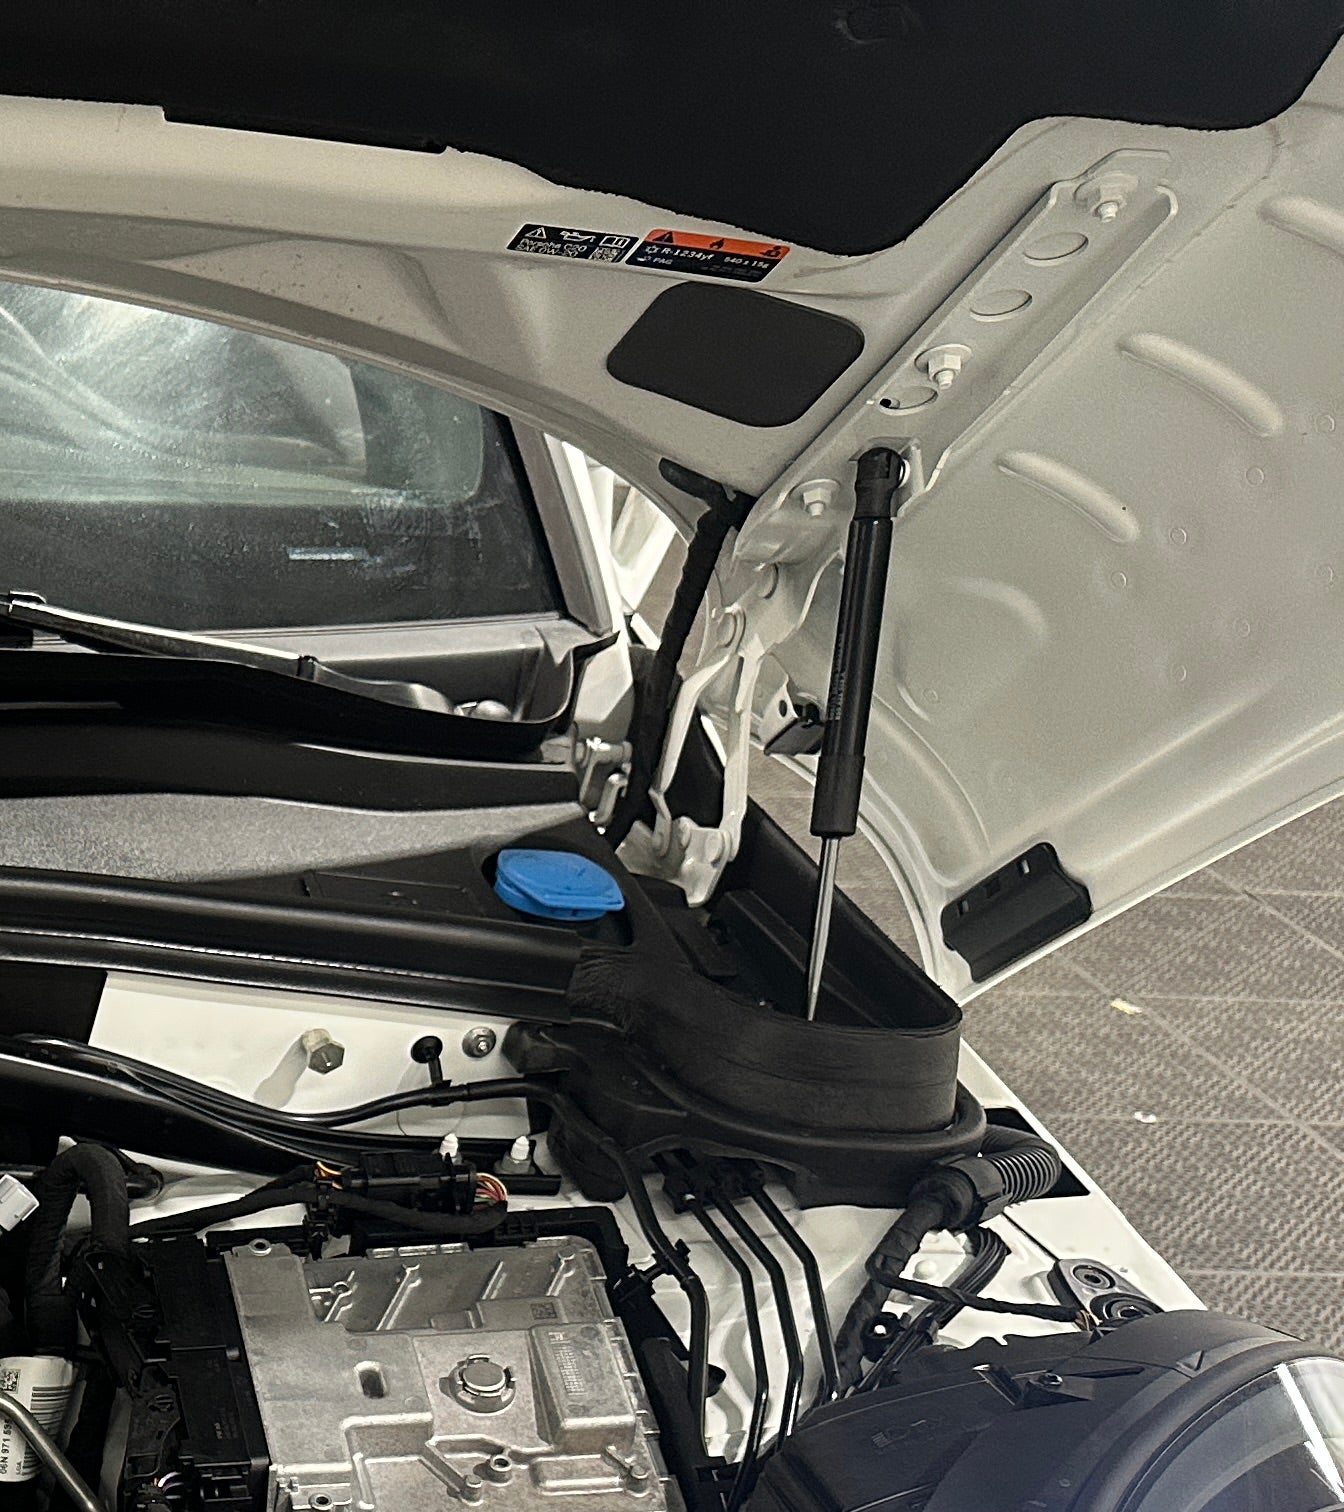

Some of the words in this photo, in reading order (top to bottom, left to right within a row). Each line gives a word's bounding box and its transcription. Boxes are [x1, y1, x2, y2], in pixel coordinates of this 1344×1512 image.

[652, 257, 674, 266] PAG
[660, 246, 716, 262] R-1234yf
[0, 1437, 10, 1454] 971
